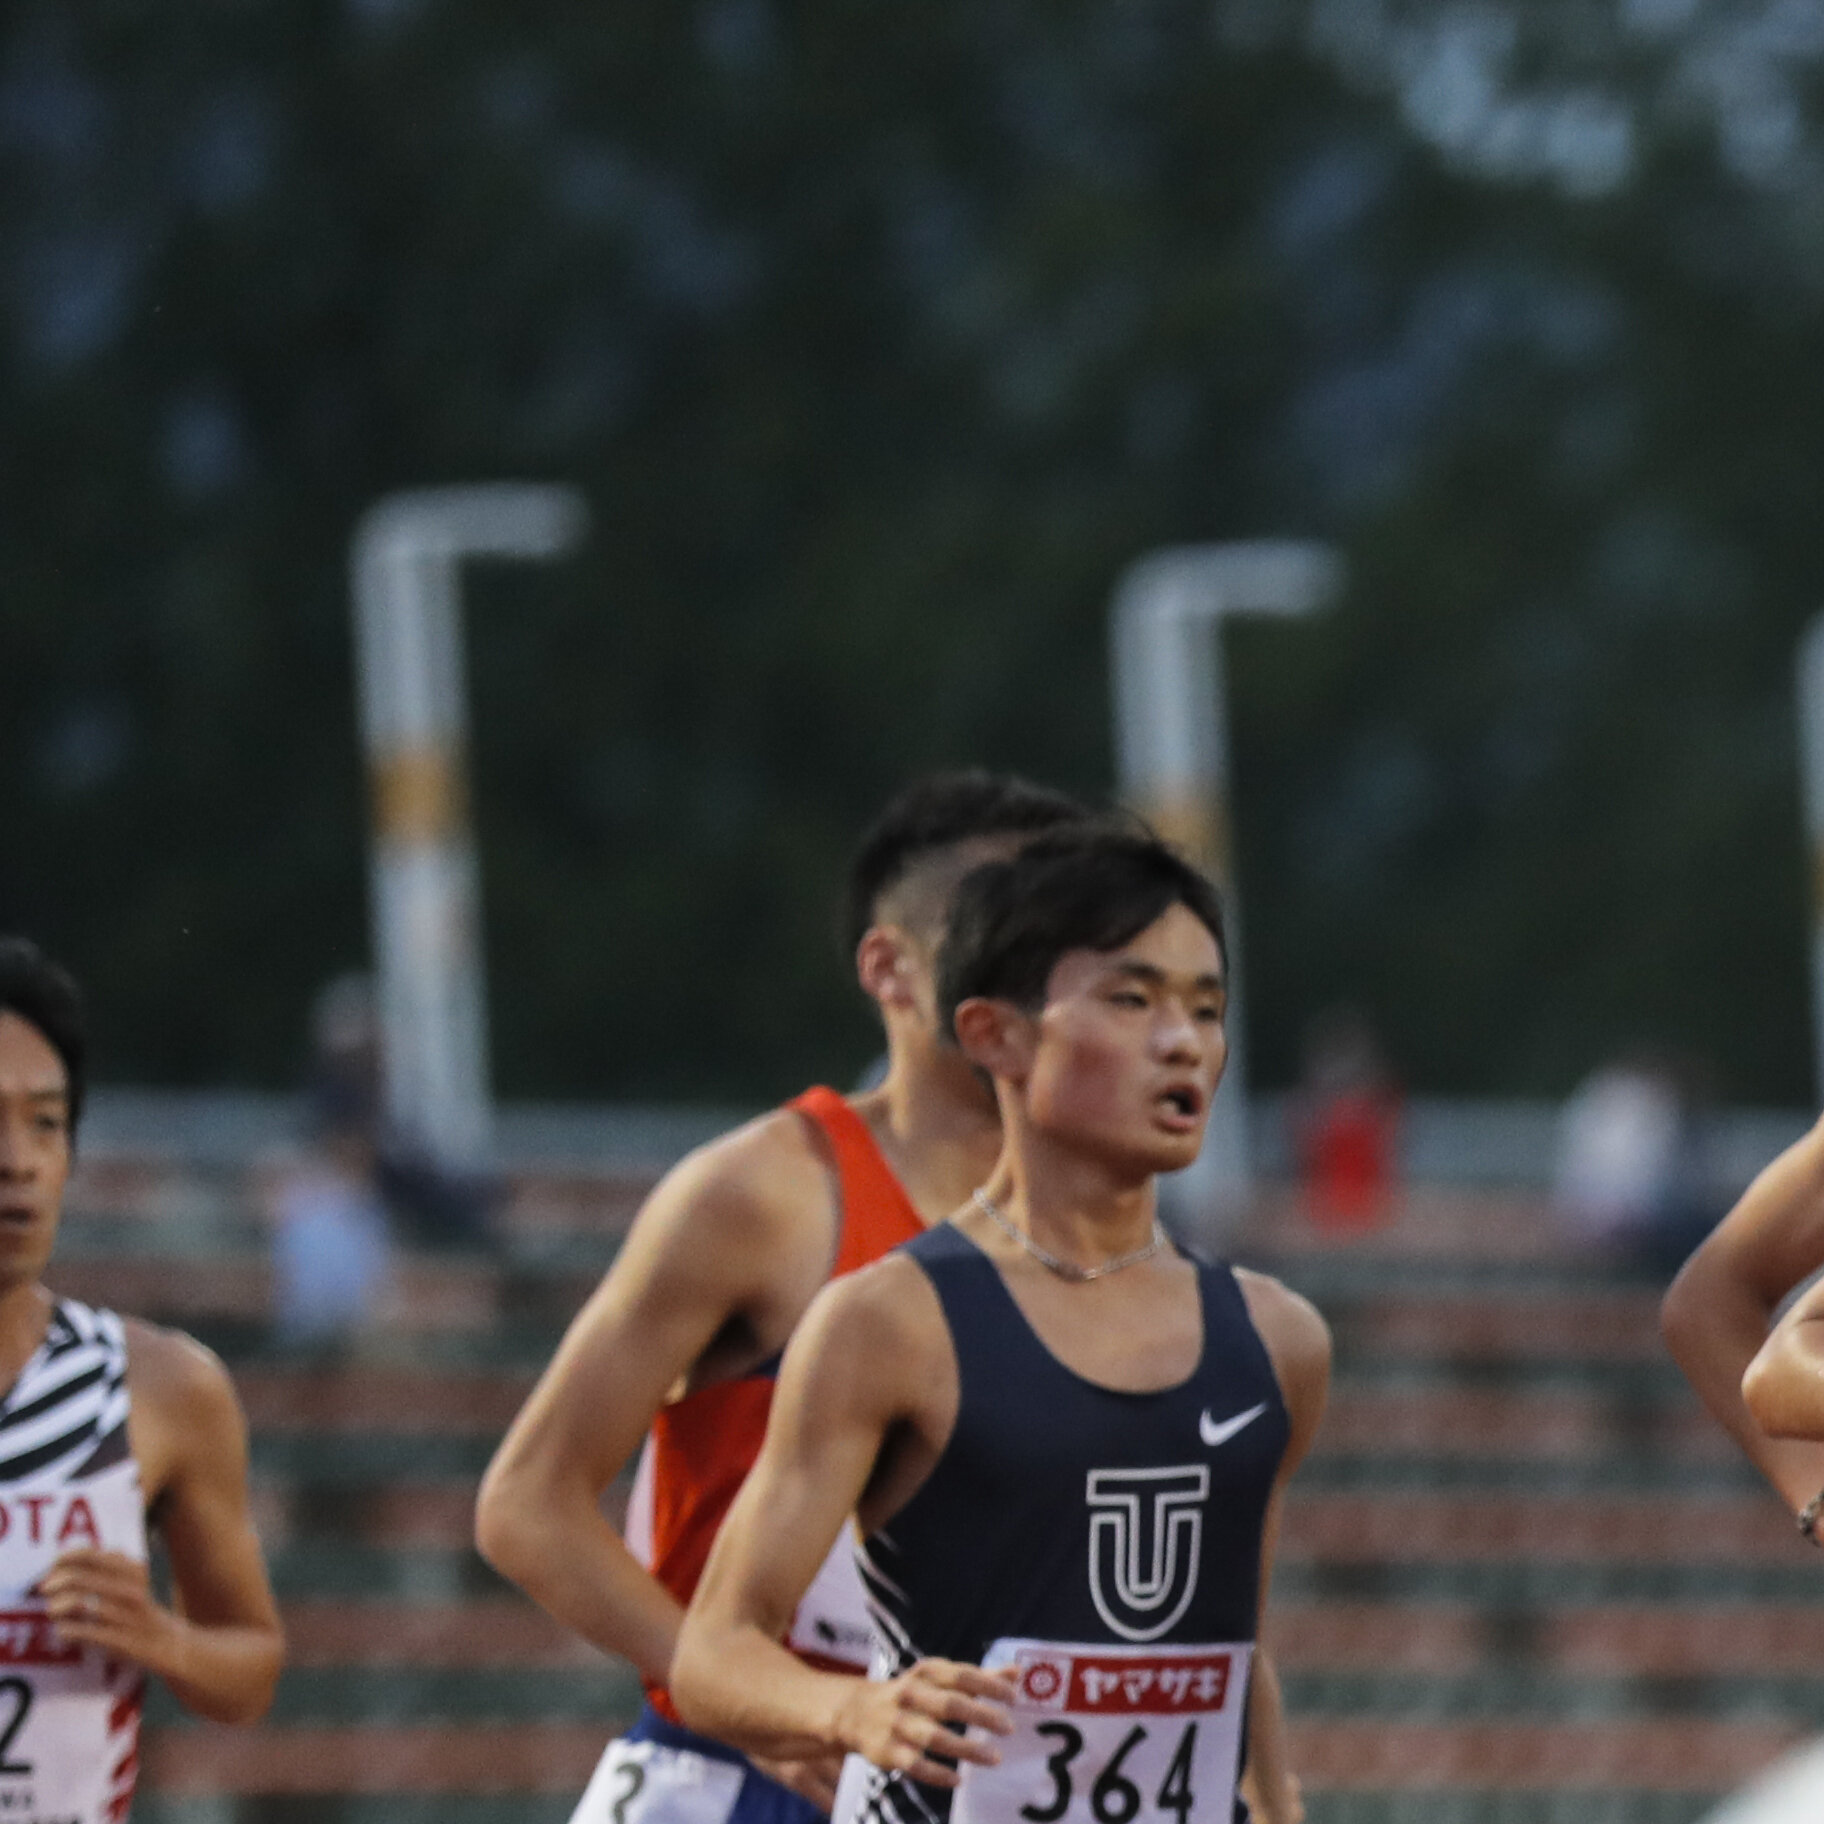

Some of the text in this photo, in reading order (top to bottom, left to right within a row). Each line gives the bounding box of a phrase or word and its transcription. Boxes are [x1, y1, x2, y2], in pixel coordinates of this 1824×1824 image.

[0, 1497, 101, 1548] TA
[1080, 1665, 1222, 1703] ヤマザキ
